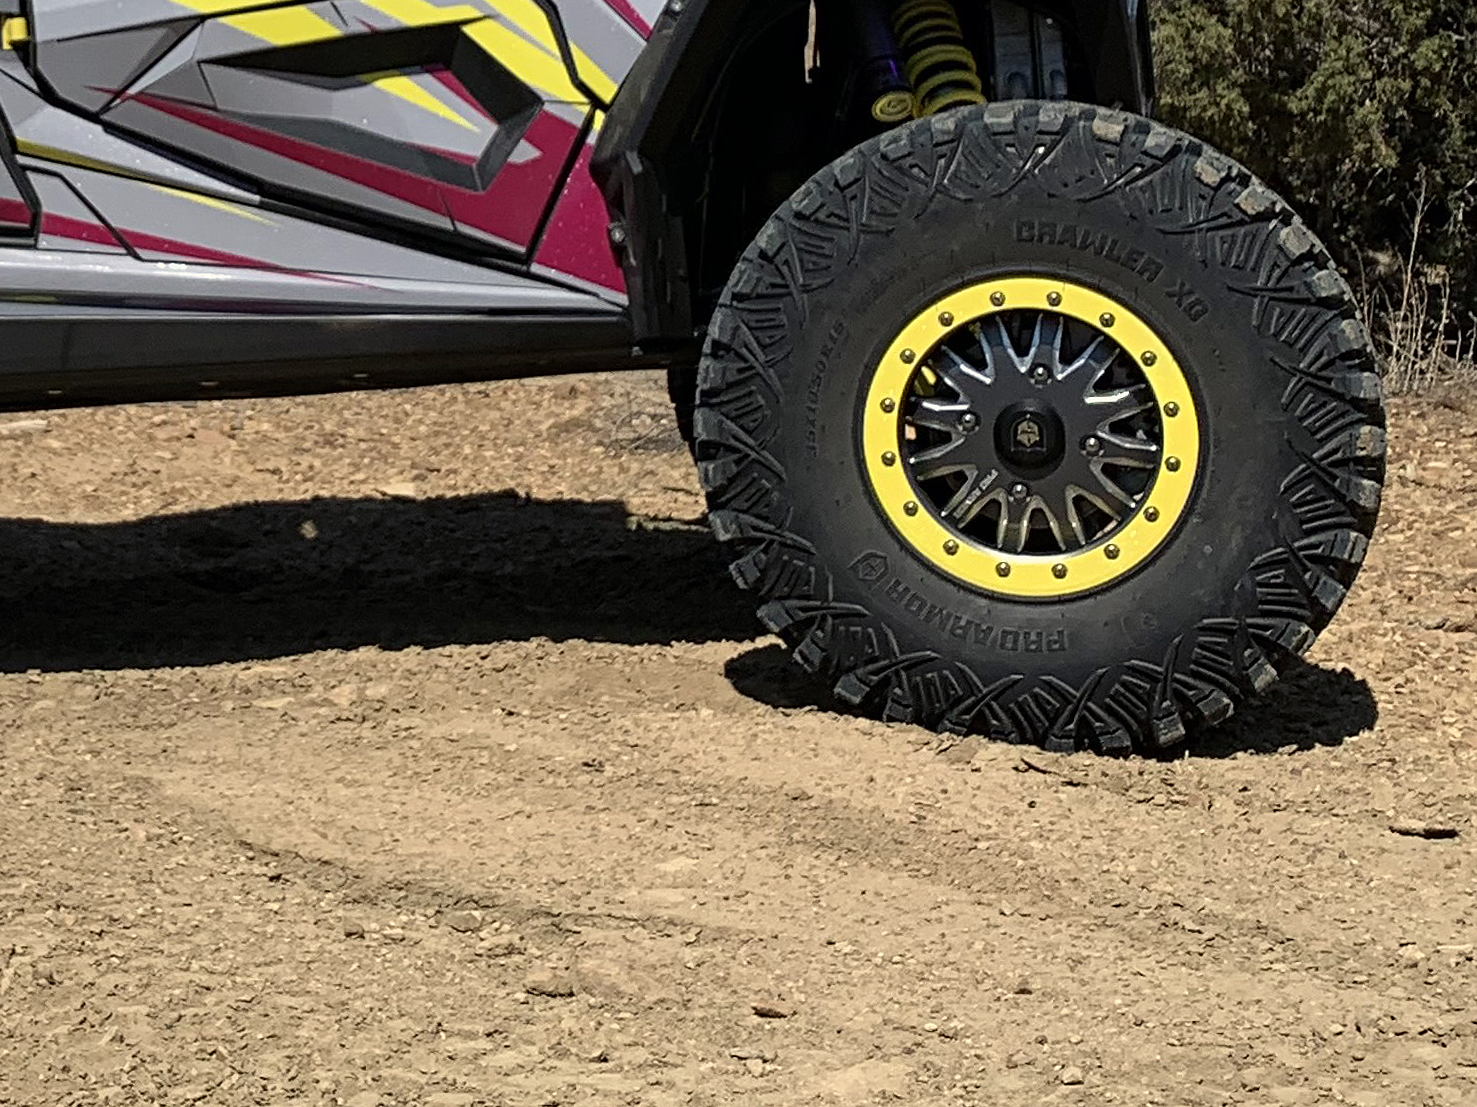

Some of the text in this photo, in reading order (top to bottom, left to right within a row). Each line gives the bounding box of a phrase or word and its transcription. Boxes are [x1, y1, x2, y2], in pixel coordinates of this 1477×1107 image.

[1013, 219, 1210, 323] CRAWLER XG
[886, 576, 1067, 653] PRO ARMOR
